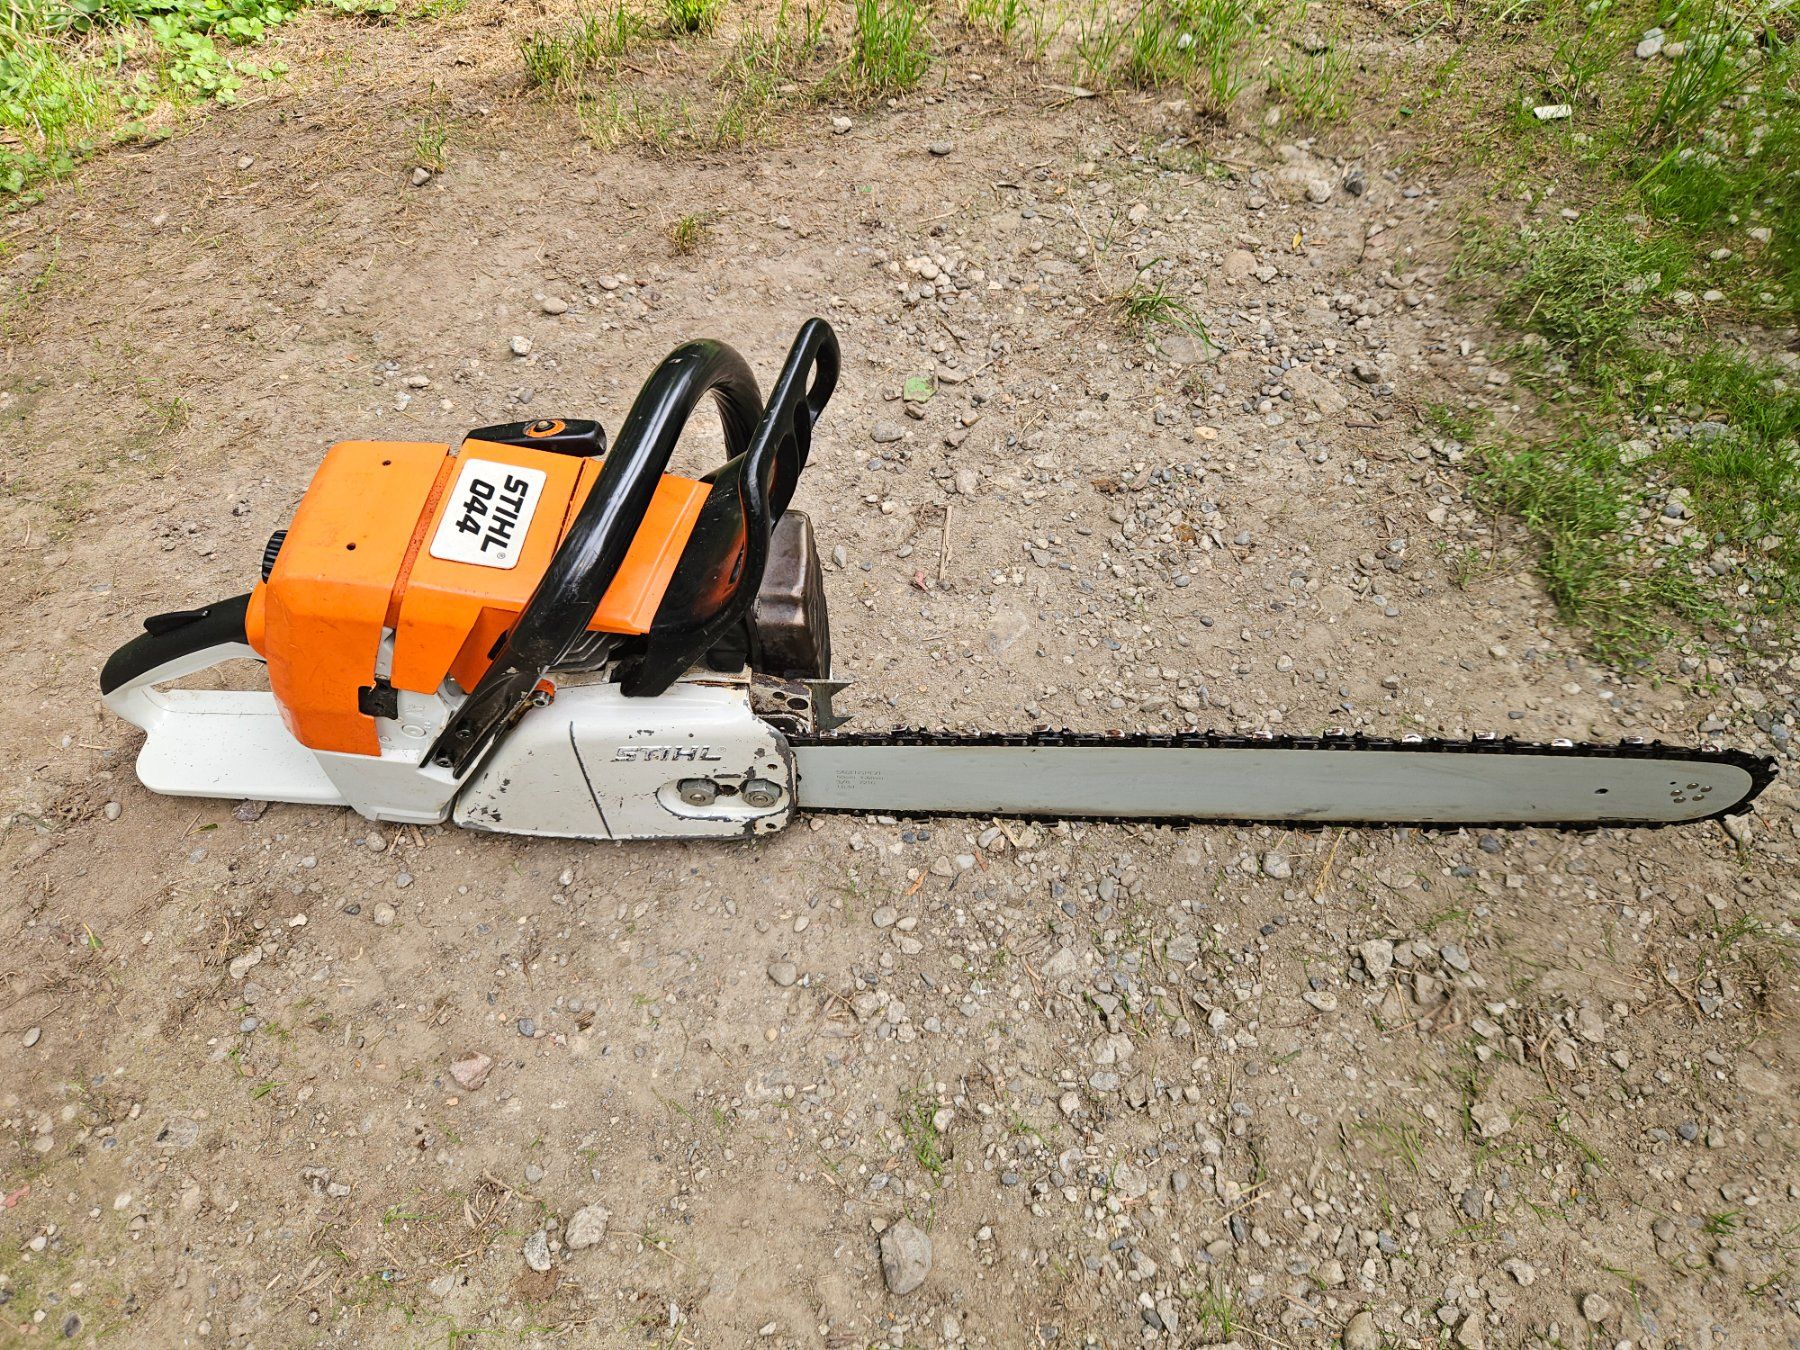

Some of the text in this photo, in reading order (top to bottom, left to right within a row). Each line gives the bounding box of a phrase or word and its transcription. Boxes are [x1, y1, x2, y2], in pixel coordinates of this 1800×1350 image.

[456, 478, 495, 536] 044
[480, 474, 529, 552] STIHL
[611, 745, 722, 761] STIHL
